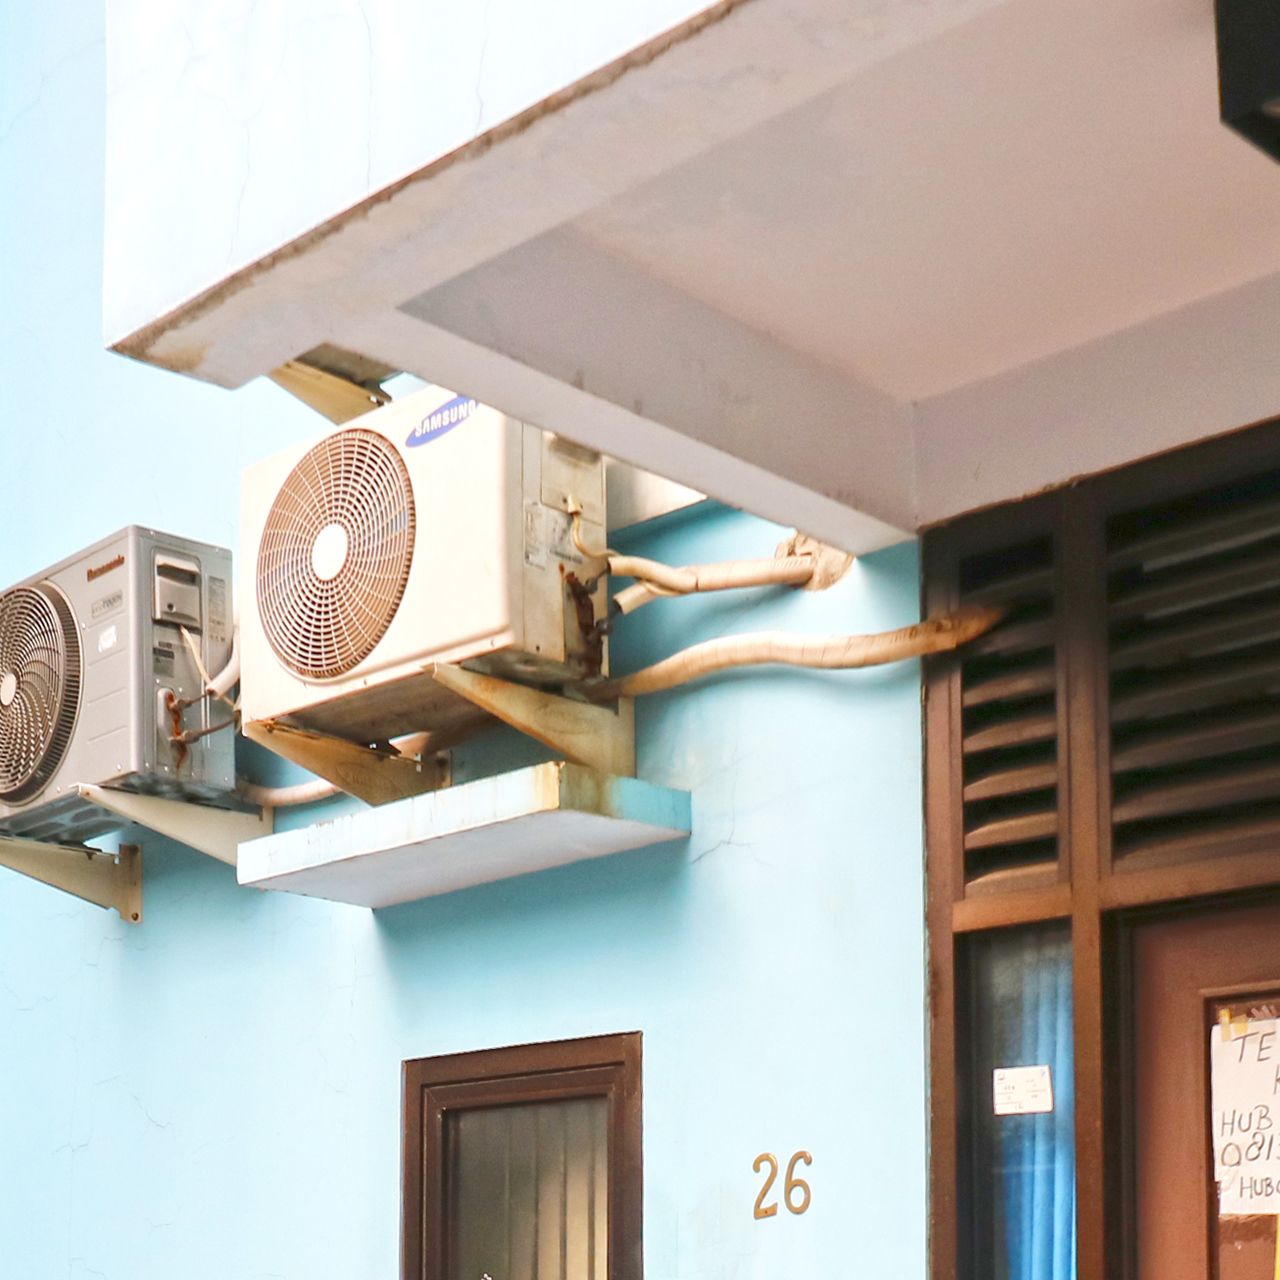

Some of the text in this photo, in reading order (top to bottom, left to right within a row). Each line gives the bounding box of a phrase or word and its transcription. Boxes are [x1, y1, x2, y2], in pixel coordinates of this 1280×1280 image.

[414, 399, 477, 437] SAMSUNG
[1221, 1104, 1273, 1137] HUB
[753, 1150, 812, 1220] 26
